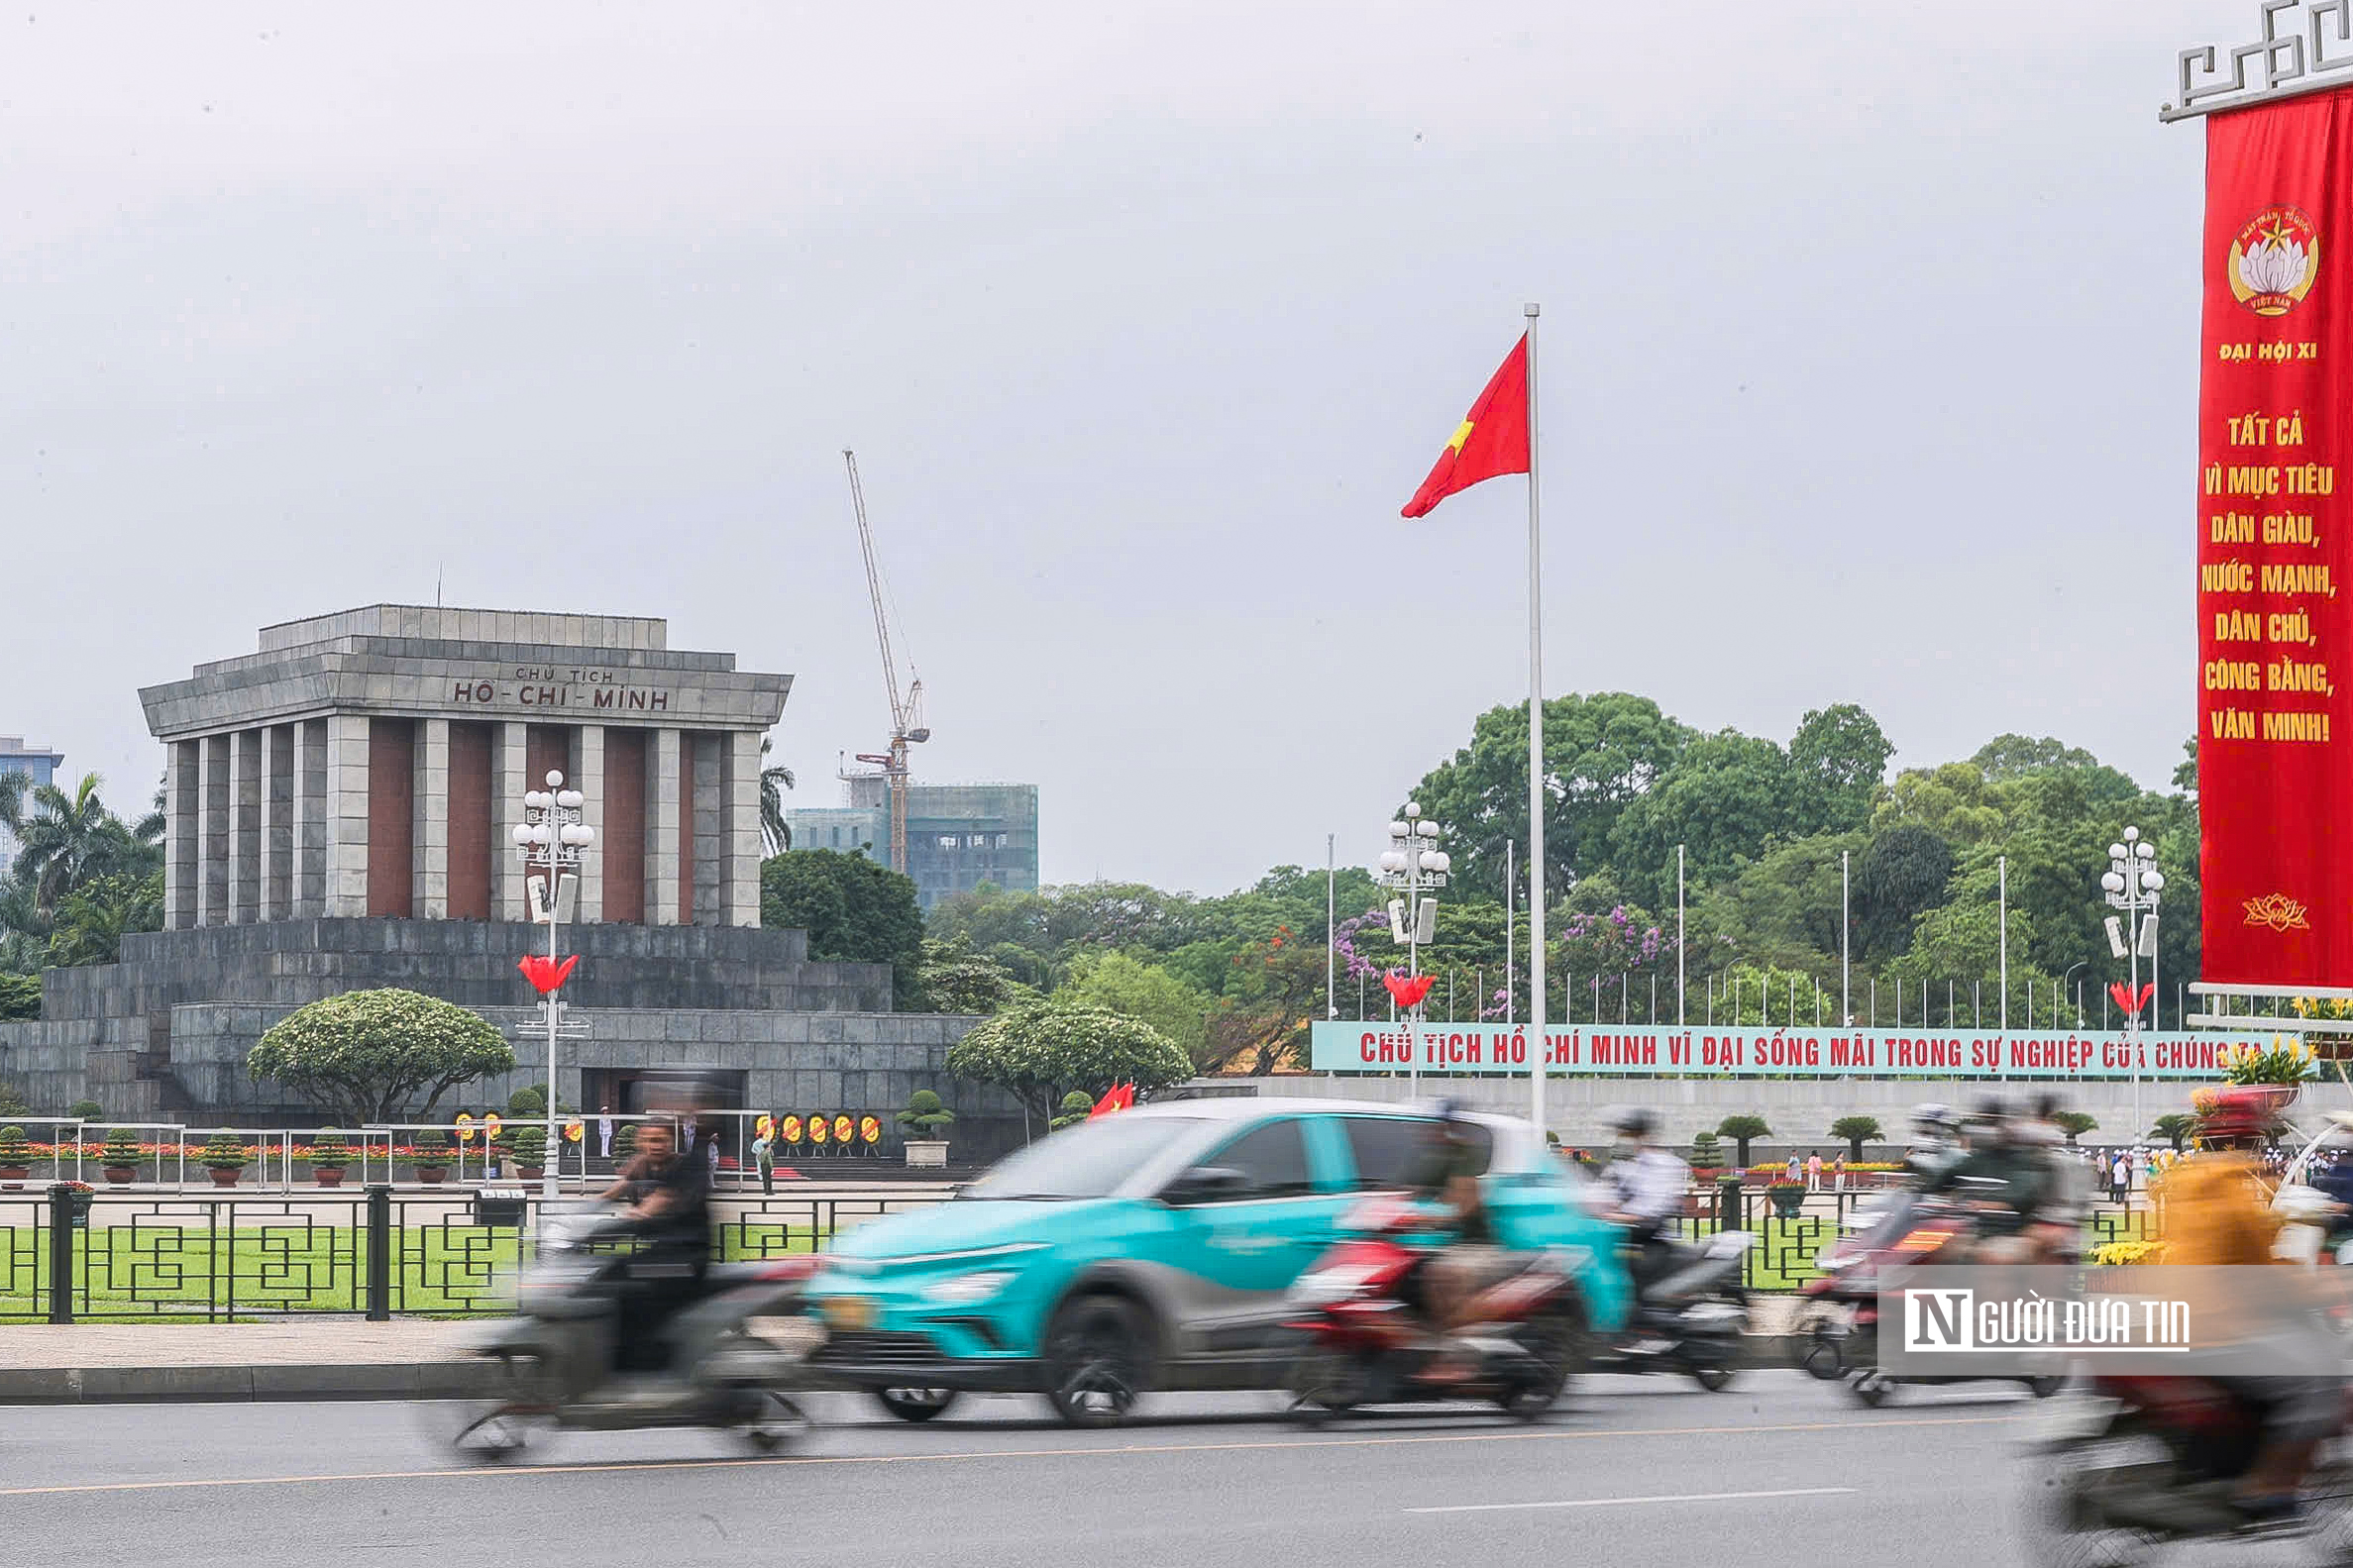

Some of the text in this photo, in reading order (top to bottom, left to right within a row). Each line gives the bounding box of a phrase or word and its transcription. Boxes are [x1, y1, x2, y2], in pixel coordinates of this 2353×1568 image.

[2219, 341, 2317, 364] ĐẠI HỘI XI
[2228, 409, 2303, 446] TẤT CẢ
[2205, 462, 2333, 500] VÌ MỤC TIÊU
[2211, 511, 2319, 548] DÂN GIÀU,
[2201, 558, 2336, 597] NƯỚC MẠNH,
[2216, 607, 2316, 647] DÂN CHỦ,
[515, 664, 554, 680] CHỦ
[2205, 655, 2334, 697] CÔNG BẰNG,
[2210, 707, 2329, 742] VĂN MINH!
[1360, 1024, 1413, 1063] CHỦ
[1424, 1033, 1481, 1069] TỊCH
[1493, 1024, 1526, 1063] HỒ
[1591, 1035, 1657, 1065] MINH
[1668, 1031, 1691, 1066] VĨ
[1702, 1036, 1743, 1071] ĐẠI
[1754, 1027, 1819, 1066] SỐNG
[1831, 1033, 1874, 1067] MÃI
[1885, 1038, 1962, 1067] TRONG
[1972, 1035, 2003, 1072] SỰ
[2010, 1035, 2093, 1073] NGHIỆP
[2102, 1031, 2146, 1069] CỦA
[2155, 1035, 2229, 1069] CHÚNG
